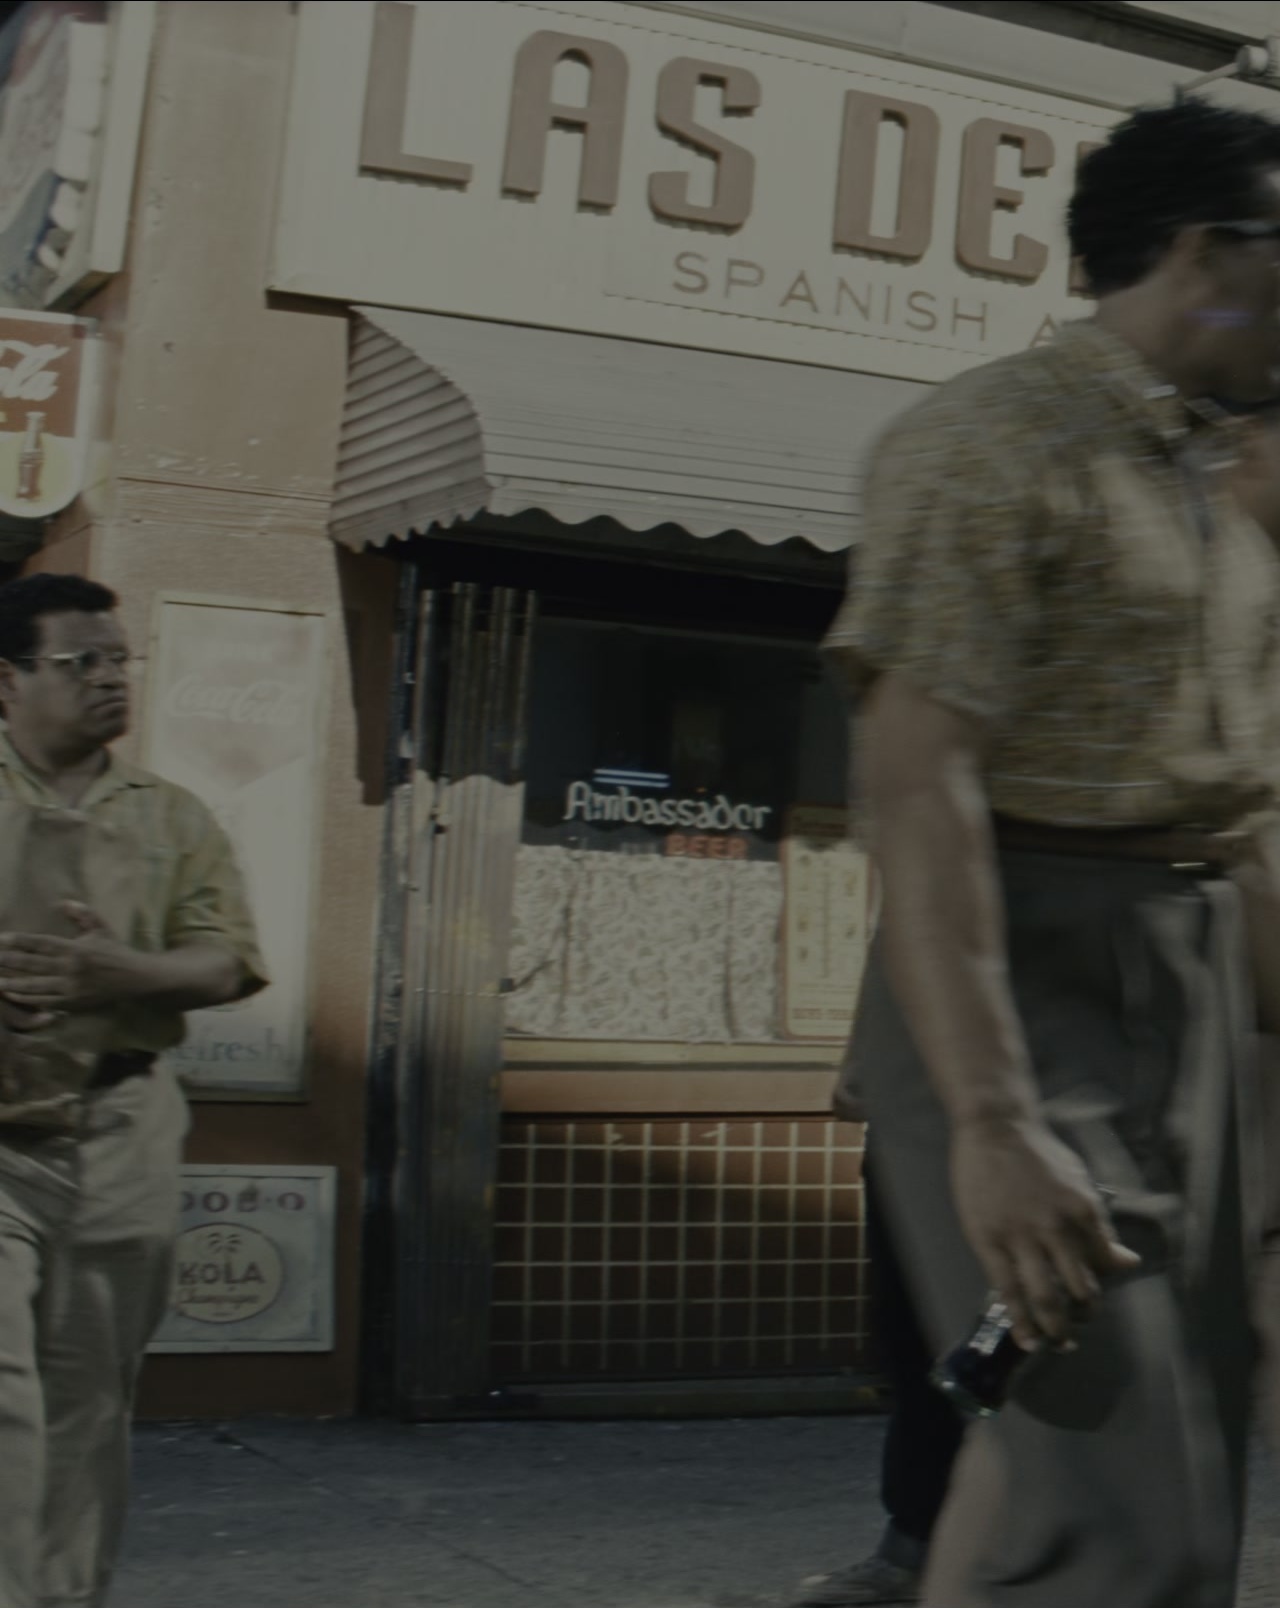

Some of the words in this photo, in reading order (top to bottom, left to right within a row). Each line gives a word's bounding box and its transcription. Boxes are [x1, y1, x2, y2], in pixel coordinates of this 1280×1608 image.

[357, 2, 763, 234] LAS
[672, 250, 989, 342] SPANISH
[564, 781, 773, 830] Ambassador
[666, 834, 748, 860] BEER
[178, 1261, 266, 1286] KOLA
